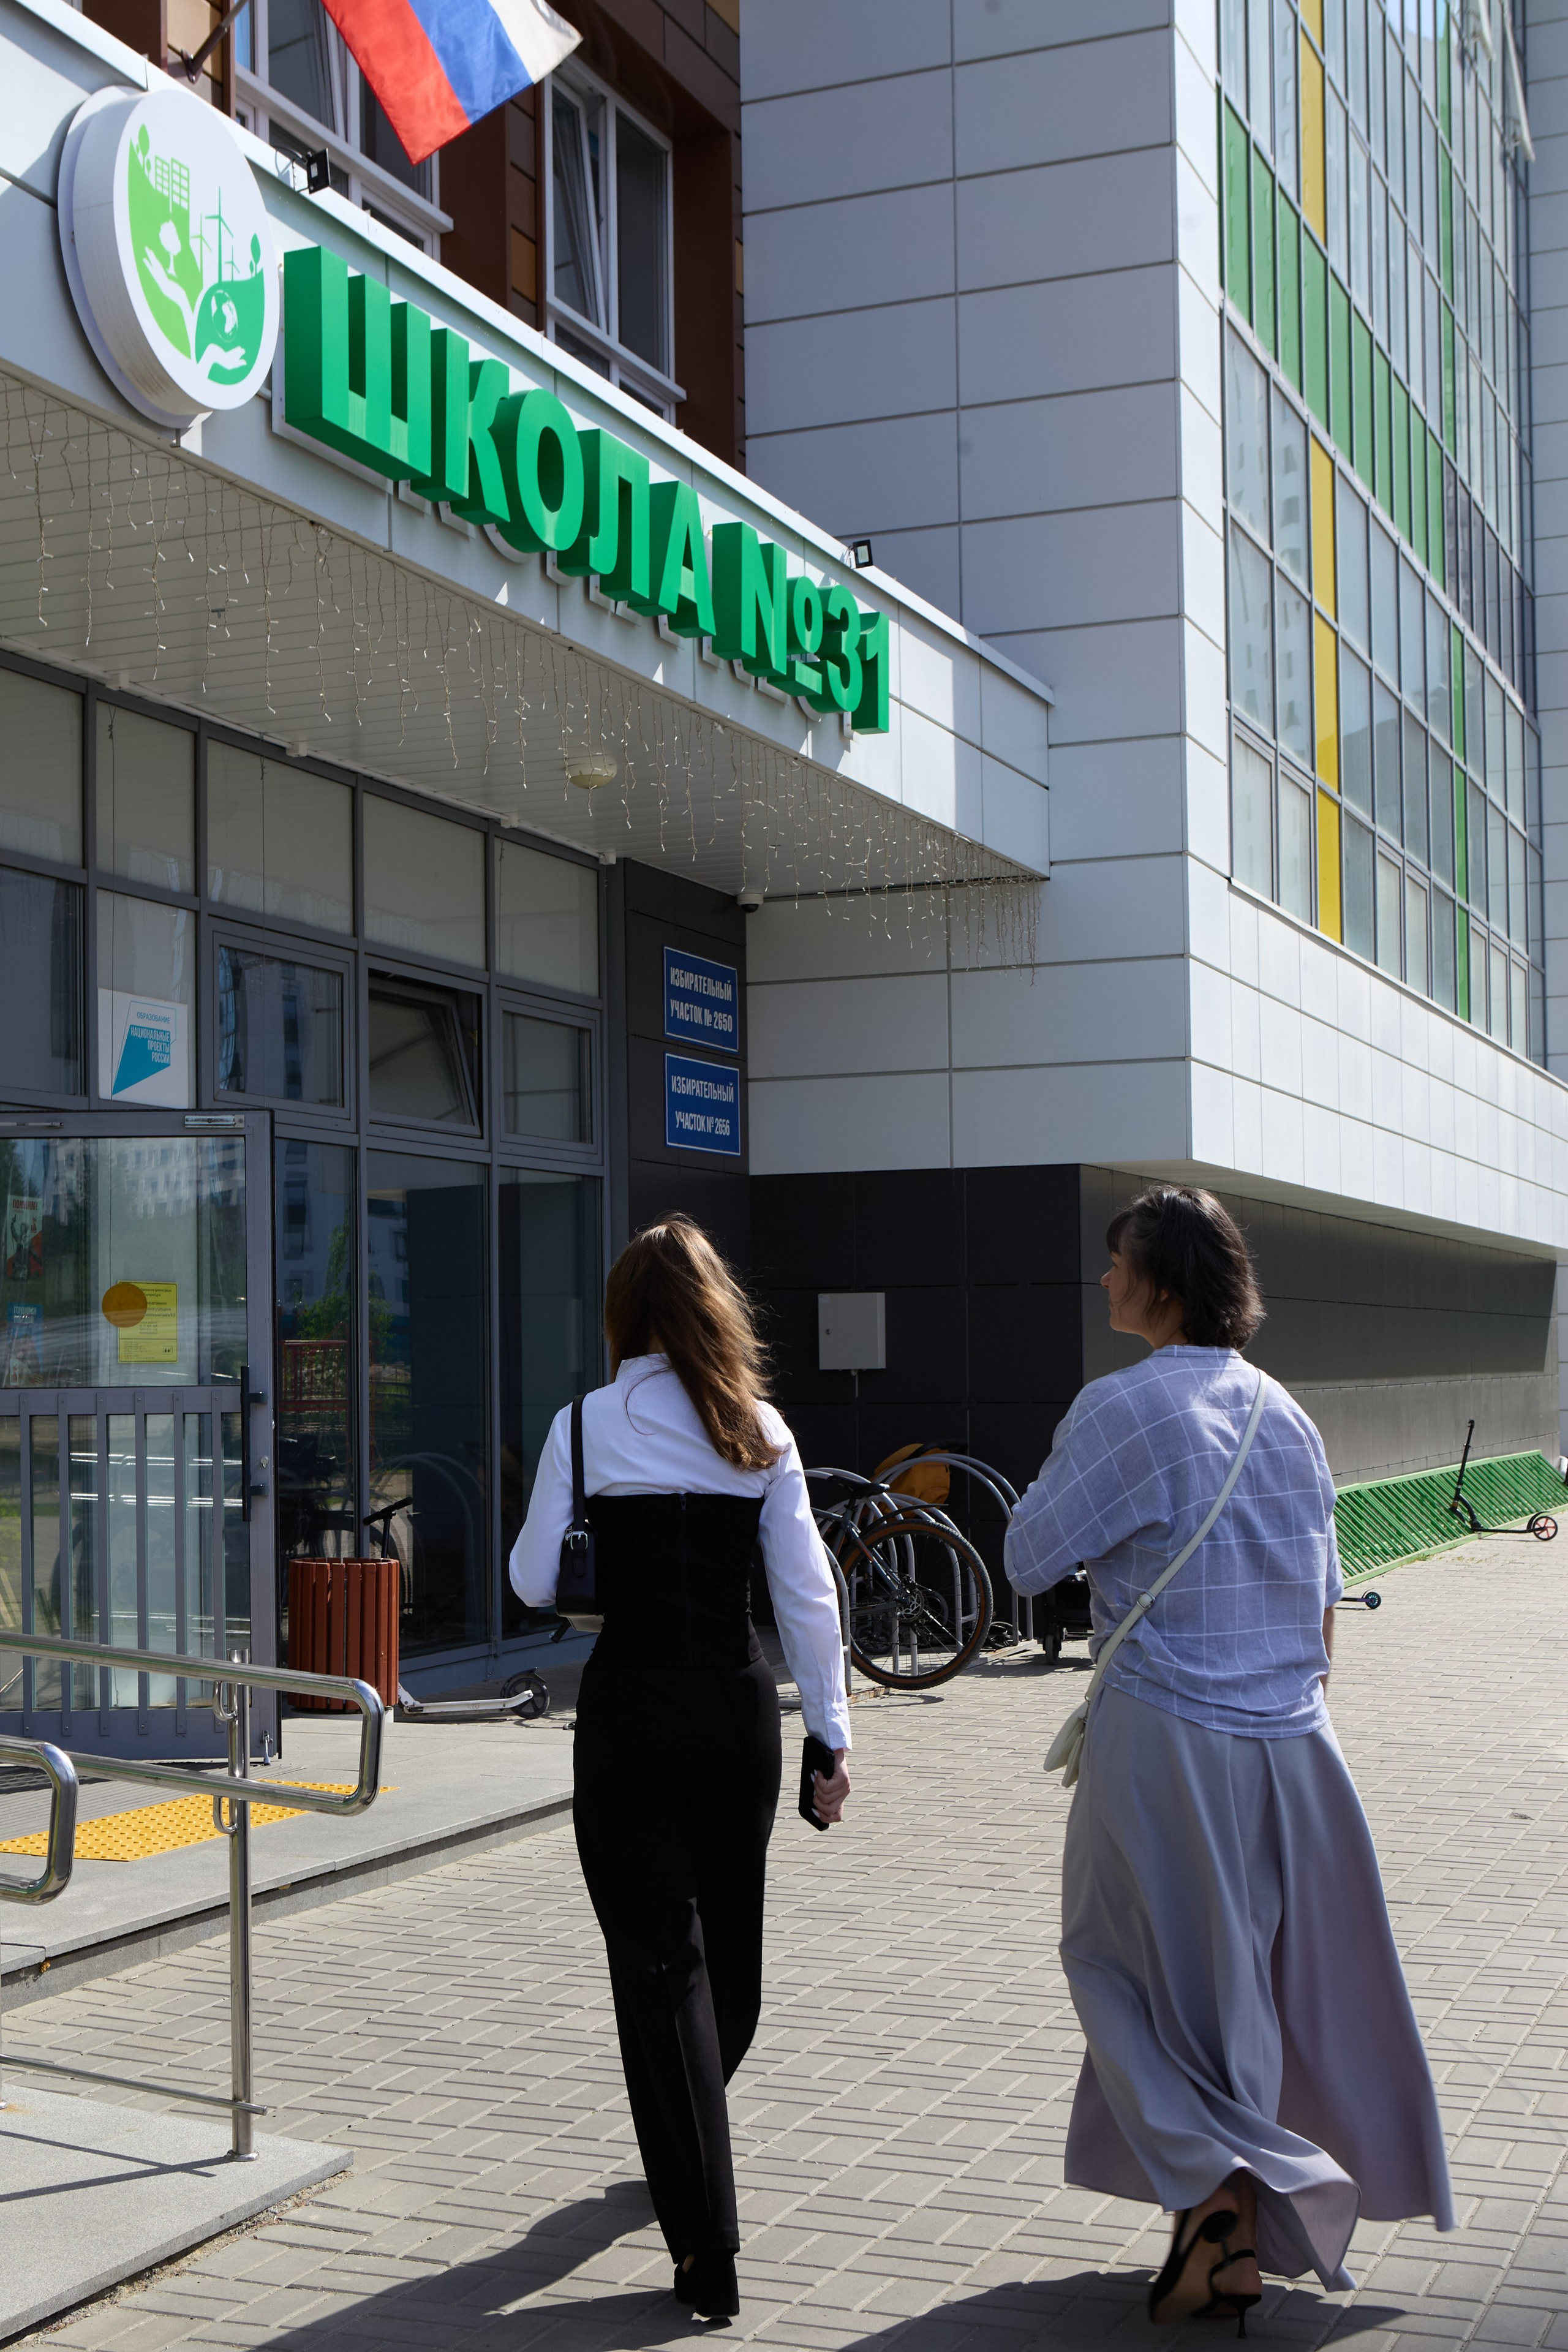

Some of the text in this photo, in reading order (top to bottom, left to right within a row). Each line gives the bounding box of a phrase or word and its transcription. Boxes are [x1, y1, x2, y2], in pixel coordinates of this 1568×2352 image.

[284, 245, 716, 638] ШКОЛА
[670, 967, 732, 1001] ИЗБИРАТЕЛЬНЫЙ
[137, 1011, 170, 1024] ОБРАЗОВАНИЕ
[670, 998, 703, 1025] УЧАСТОК
[714, 1011, 733, 1033] 2650
[130, 1025, 170, 1042] НАЦИОНАЛЬНЫЕ
[147, 1039, 170, 1054] ПРОЕКТЫ
[151, 1051, 170, 1064] РОССИИ
[671, 1075, 734, 1103] ИЗБИРАТЕЛЬНЫЙ
[675, 1110, 706, 1133] УЧАСТОК
[715, 1118, 730, 1136] 2656
[12, 1199, 38, 1211] ПОМНИМ!
